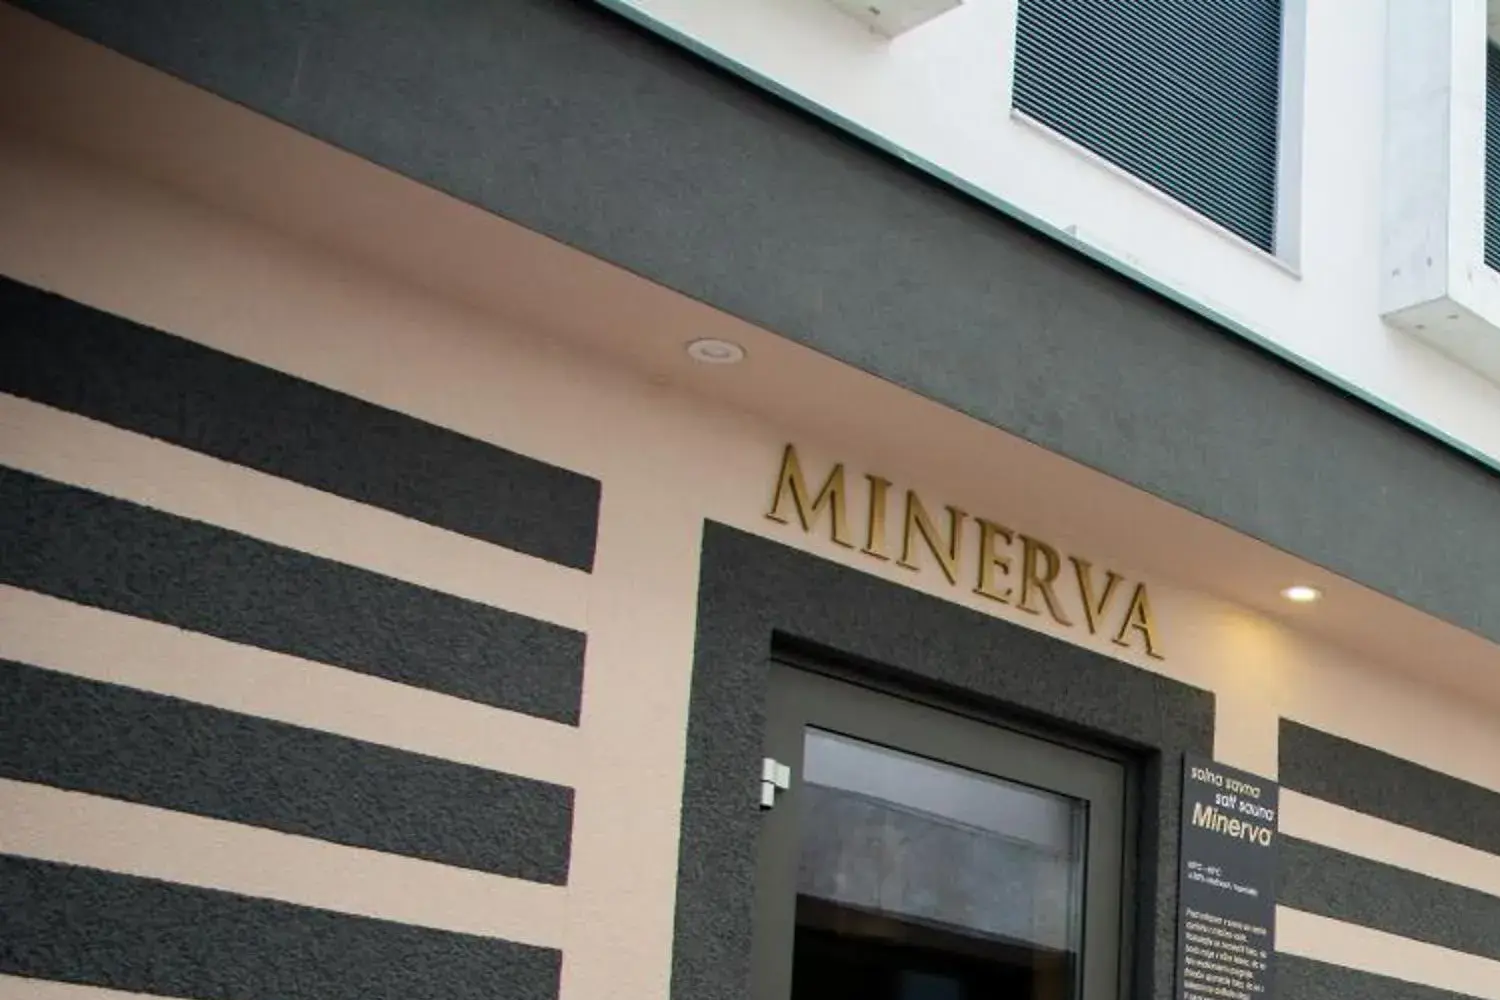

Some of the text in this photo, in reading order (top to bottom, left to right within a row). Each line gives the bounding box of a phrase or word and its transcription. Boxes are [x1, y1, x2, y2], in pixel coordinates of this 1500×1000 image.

[764, 442, 1166, 661] MINERVA
[1191, 801, 1273, 847] Minerva
[1215, 793, 1275, 821] salt sauna
